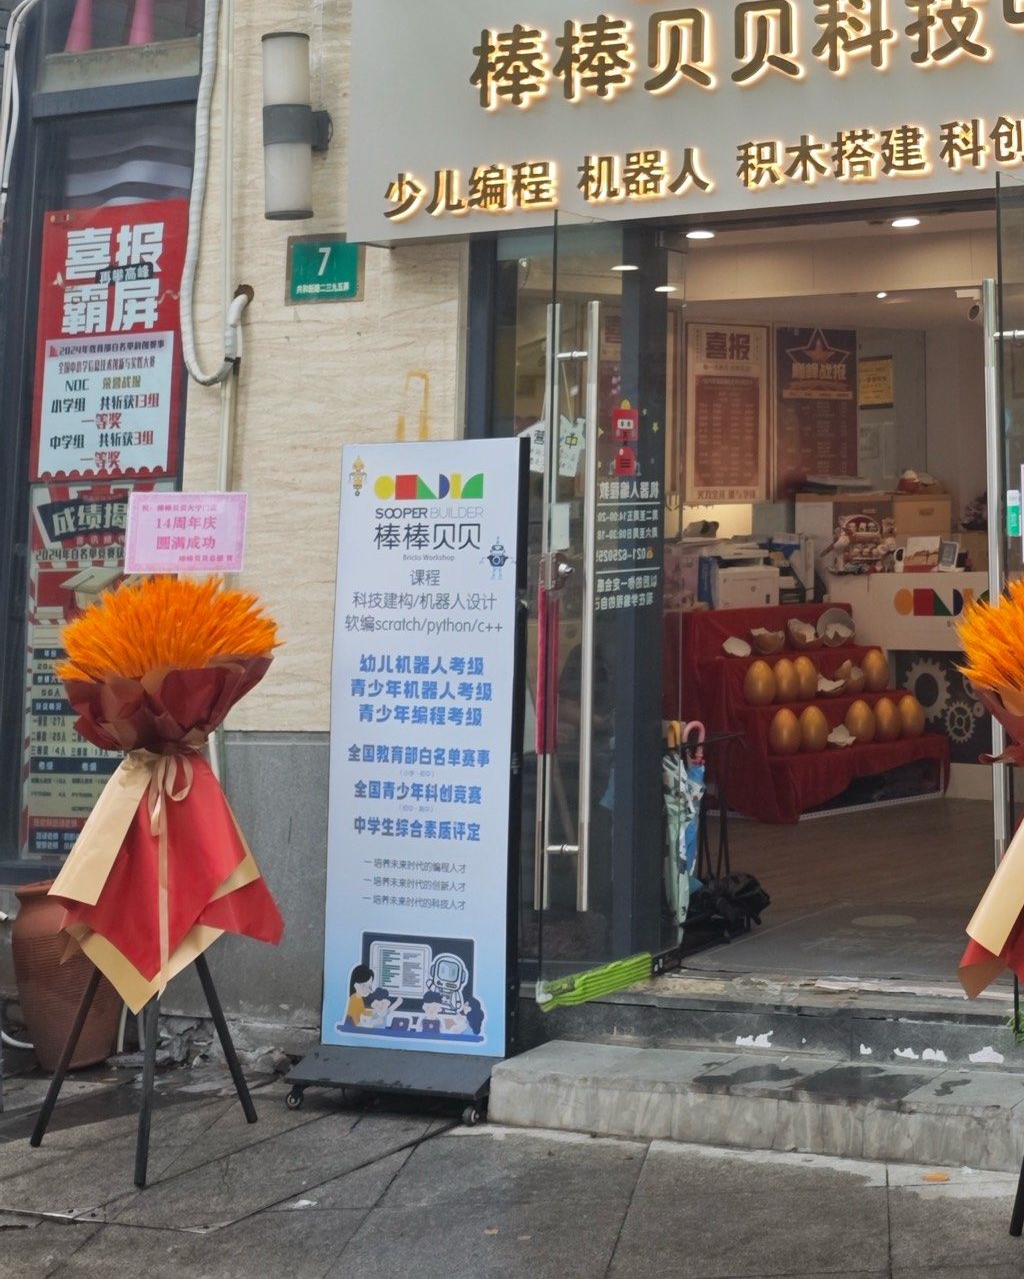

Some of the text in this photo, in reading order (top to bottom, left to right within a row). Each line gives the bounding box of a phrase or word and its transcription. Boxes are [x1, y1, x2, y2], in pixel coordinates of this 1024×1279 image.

[383, 160, 556, 218] 少儿编程
[577, 146, 711, 199] 机器人
[735, 128, 927, 185] 积木搭建
[65, 222, 165, 280] 喜报
[318, 247, 331, 276] 7
[61, 278, 160, 335] 霸屏
[706, 332, 750, 360] 喜报
[65, 378, 89, 392] NOC
[51, 393, 159, 413] 小学组 共斩获13组
[81, 413, 122, 430] 一等奖
[50, 430, 154, 450] 中学组 共斩获3组
[80, 451, 121, 468] 一等奖
[156, 516, 217, 530] 14周年庆
[375, 506, 485, 519] SOOPER BUILDER
[156, 536, 216, 551] 圆满成功
[374, 522, 481, 550] 棒棒贝贝
[423, 554, 455, 562] Workshop
[410, 569, 440, 586] 课程
[352, 592, 497, 611] 科技建构/机器人设计
[345, 614, 503, 635] 软编scratch/python/c++
[359, 654, 484, 676] 幼儿机器人考级
[351, 679, 492, 701] 青少年机器人考级
[359, 704, 482, 726] 青少年编程考级
[348, 744, 490, 768] 全国教育部白名单赛事
[354, 780, 482, 805] 全国青少年科创竞赛
[354, 817, 481, 842] 中学生综合素质评定
